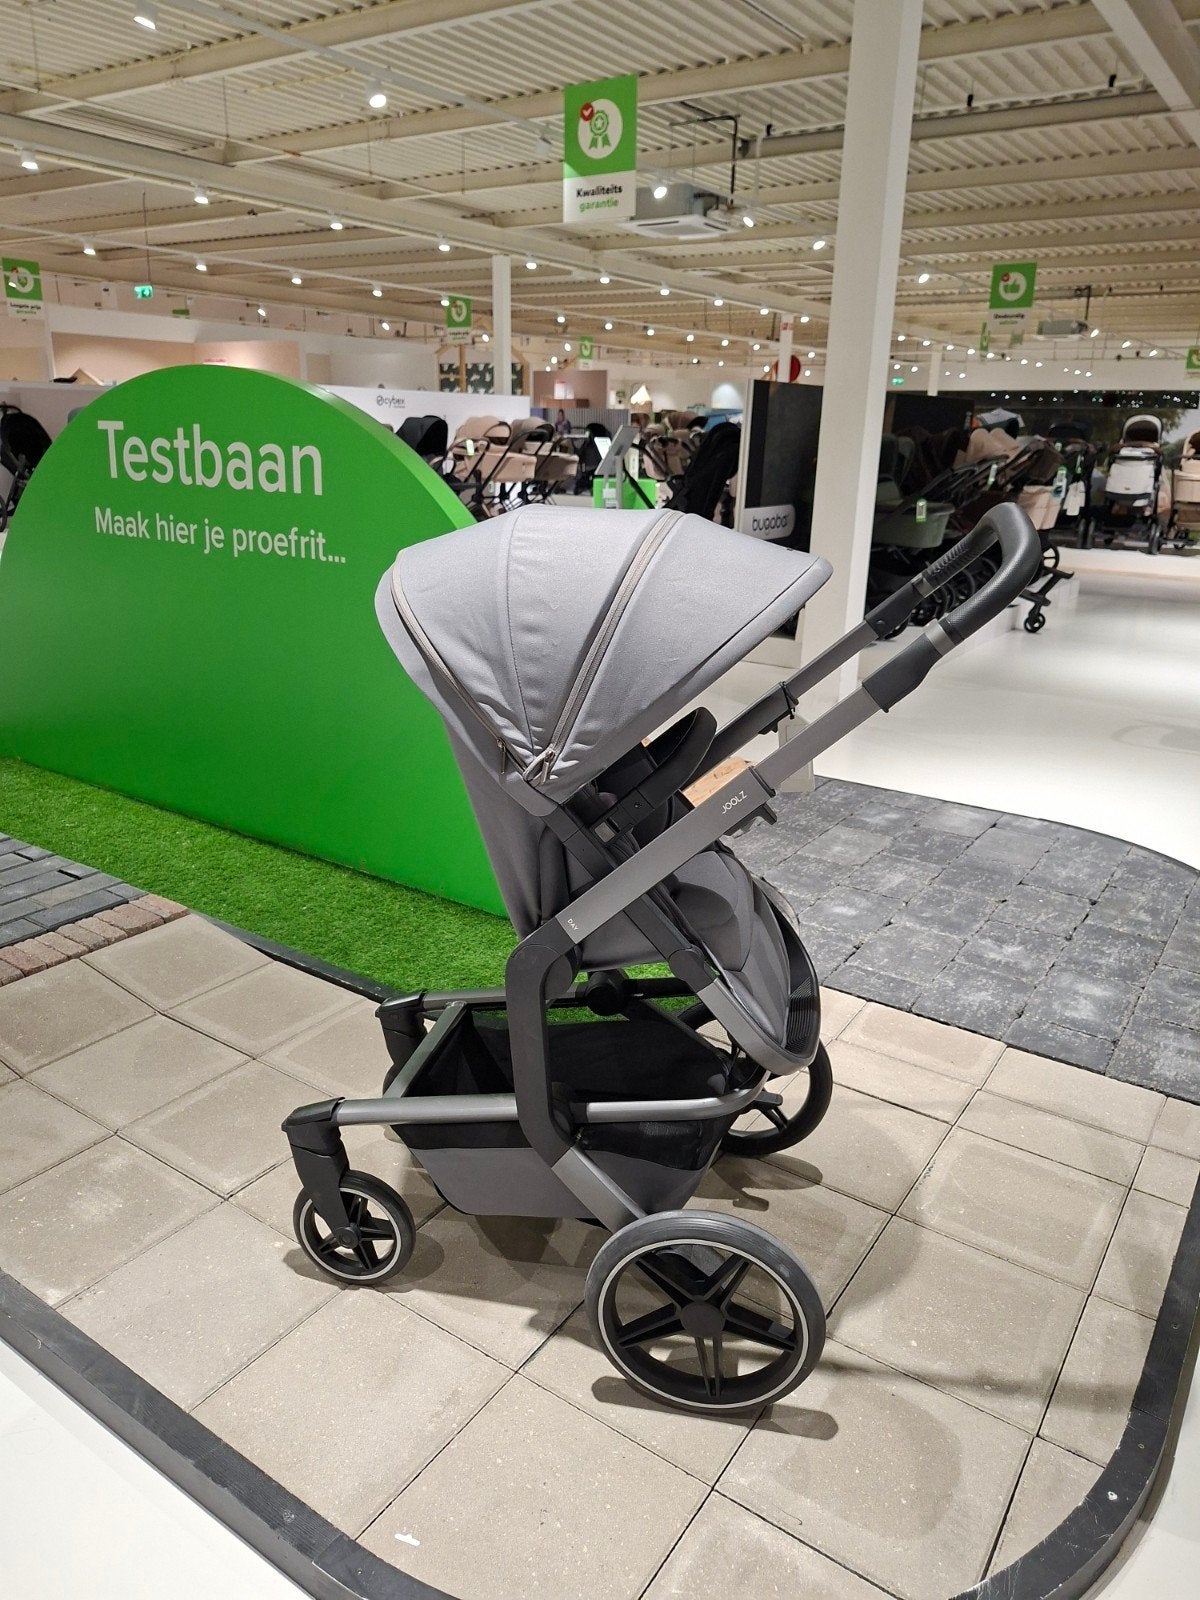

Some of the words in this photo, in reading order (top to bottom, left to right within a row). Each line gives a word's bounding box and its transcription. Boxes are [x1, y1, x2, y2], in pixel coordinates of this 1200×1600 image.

[576, 185, 622, 197] Kwaliteits
[579, 198, 619, 212] garantie
[97, 420, 323, 496] Testbaan
[94, 506, 150, 539] Maak
[155, 512, 198, 545] hier
[203, 518, 225, 554] je
[232, 526, 347, 564] proefrit...
[721, 790, 748, 814] JOOLZ
[567, 918, 579, 930] DAY
